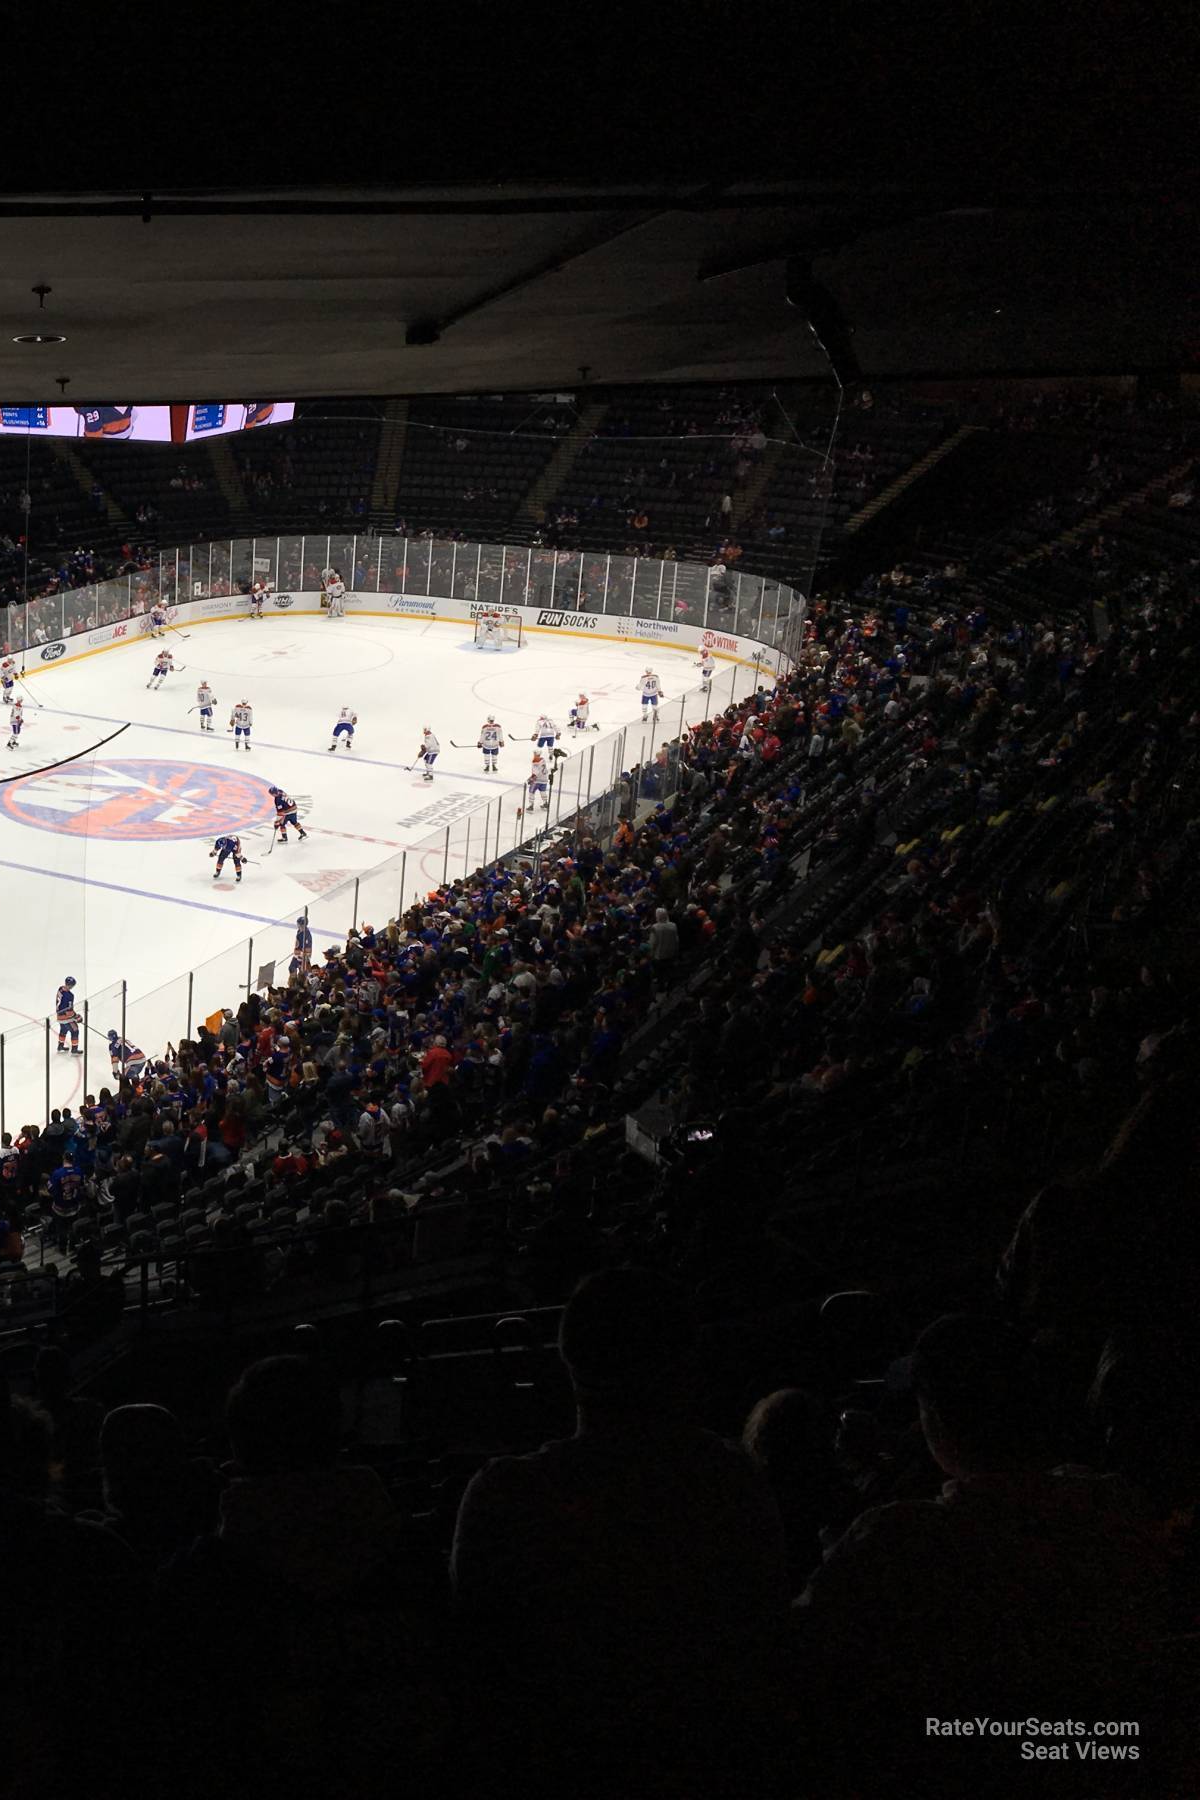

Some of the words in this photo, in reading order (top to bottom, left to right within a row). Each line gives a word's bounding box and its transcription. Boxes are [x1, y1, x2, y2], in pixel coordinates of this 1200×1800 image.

[86, 411, 100, 423] 29
[390, 595, 436, 609] Paramount
[539, 611, 563, 626] FUN
[563, 614, 599, 629] SOCKS
[636, 619, 679, 633] Northwell
[112, 625, 128, 639] ACE
[44, 645, 63, 660] Ford
[645, 680, 657, 689] 40
[485, 731, 497, 741] 24
[396, 792, 472, 828] AMERICAN
[425, 794, 493, 828] EXPRESS
